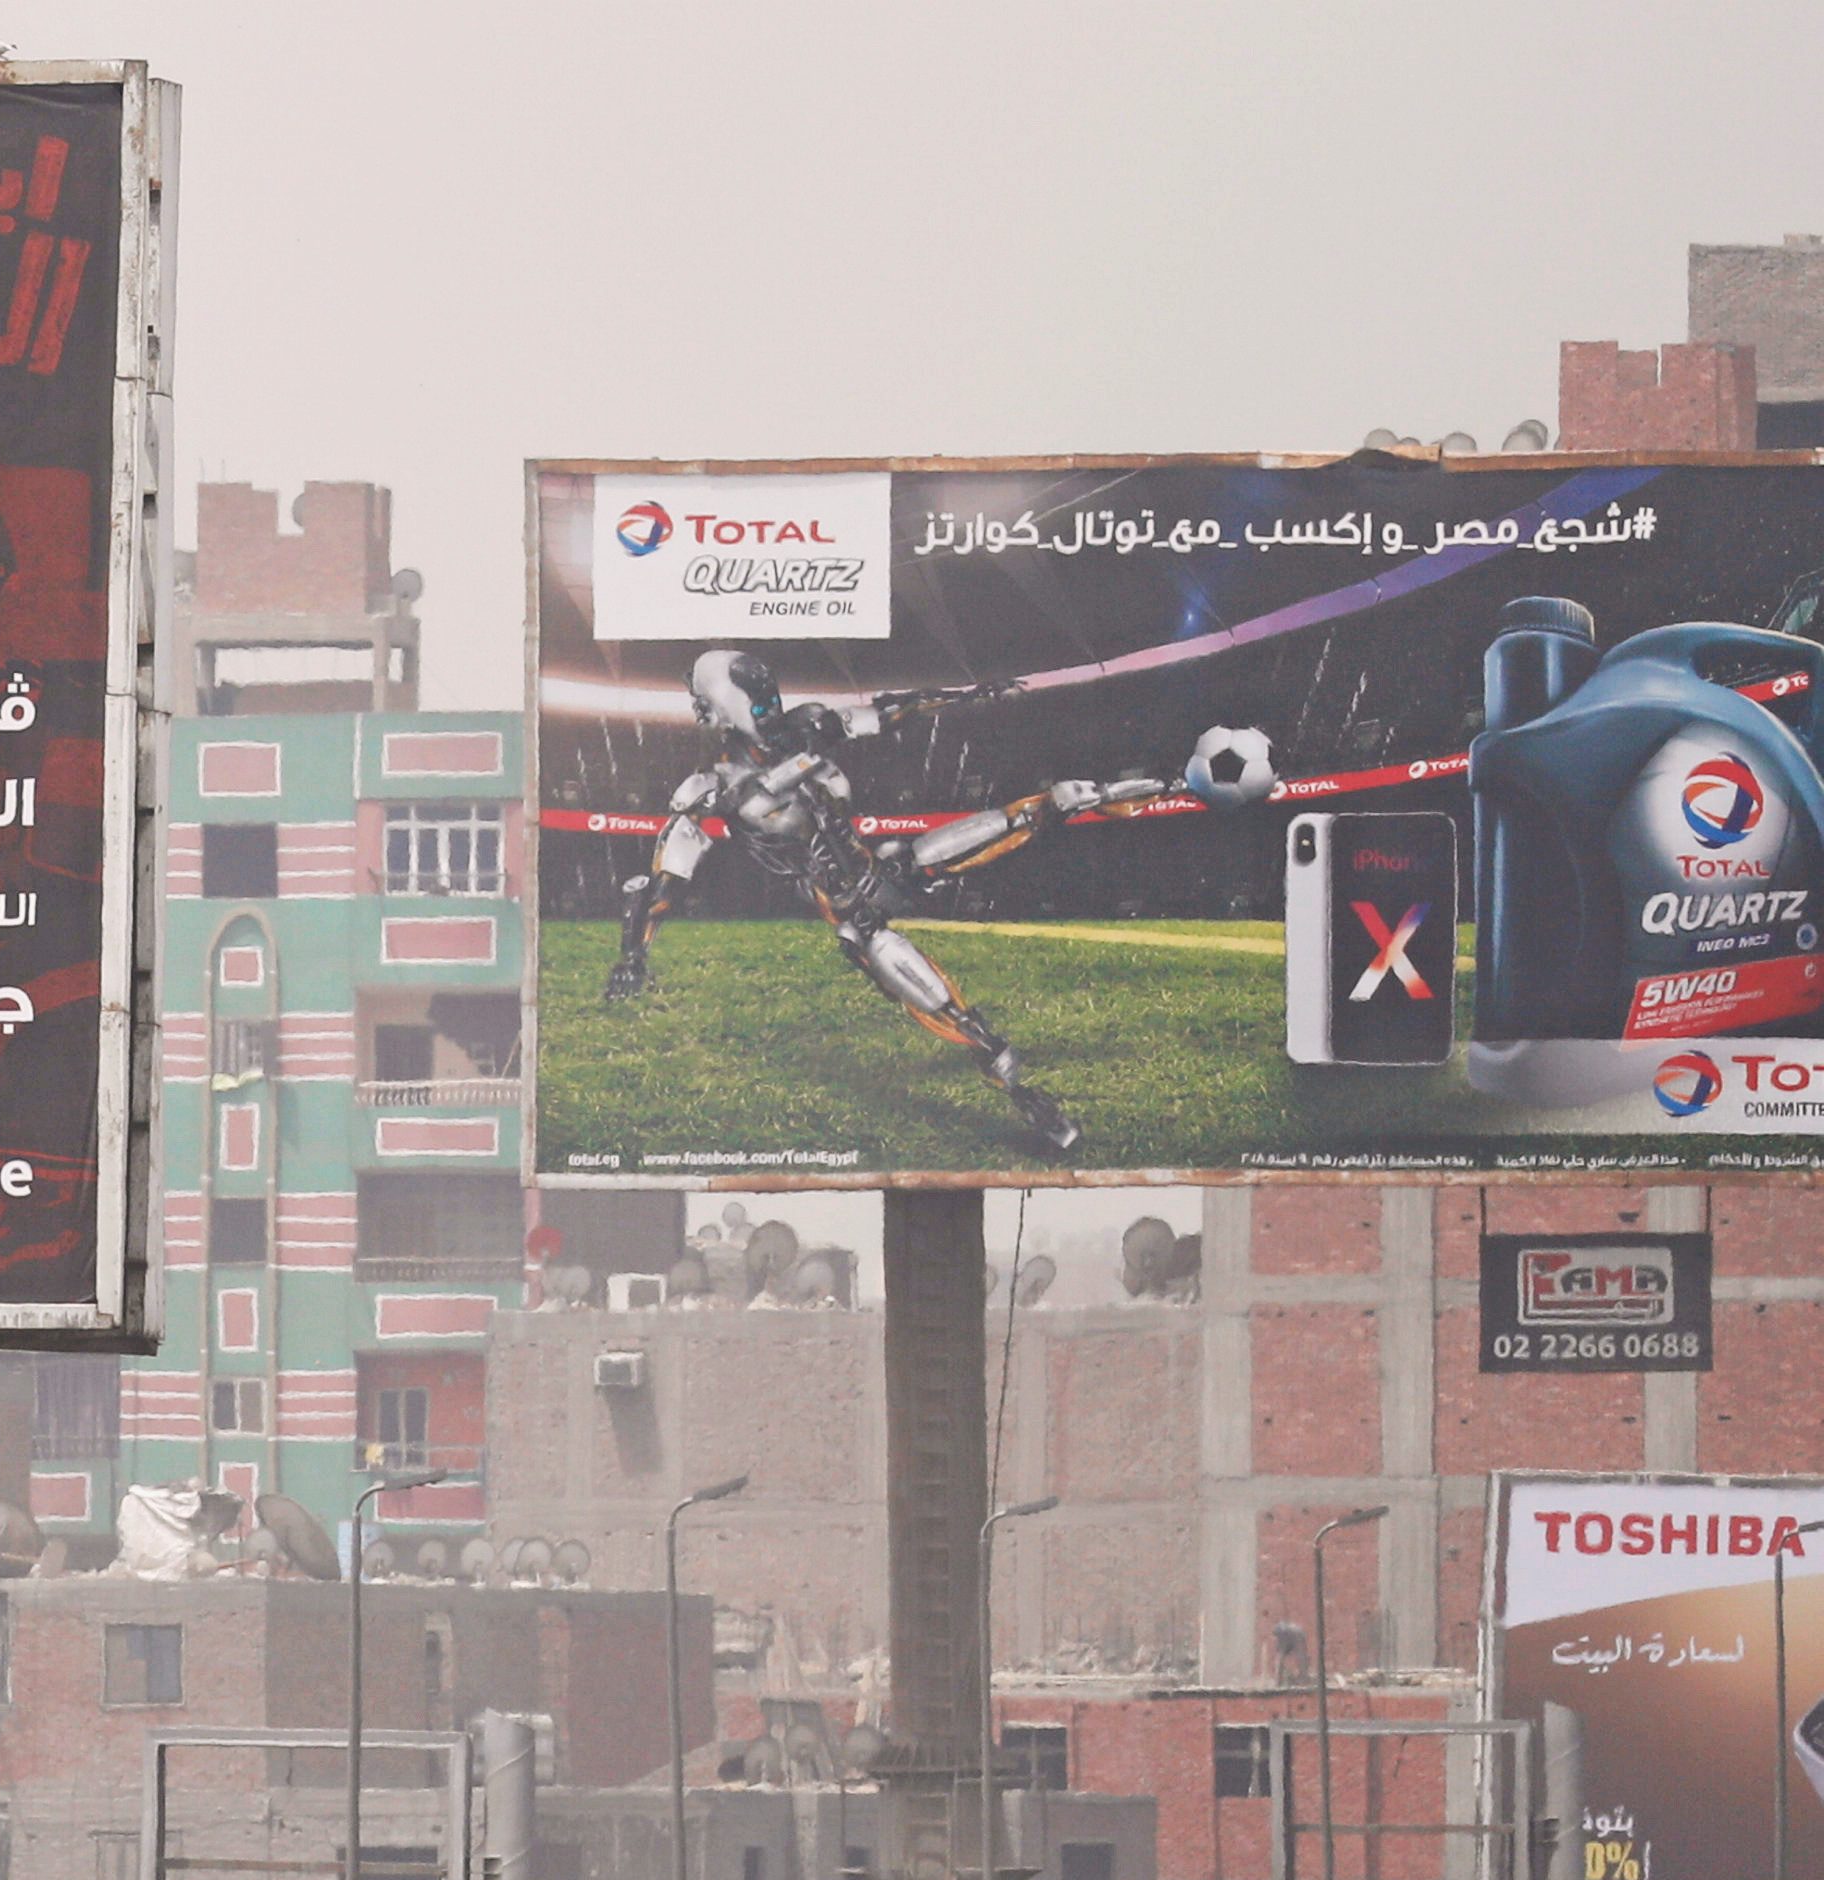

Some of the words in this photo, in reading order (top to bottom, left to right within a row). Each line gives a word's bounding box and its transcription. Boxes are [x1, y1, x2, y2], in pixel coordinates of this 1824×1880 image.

[686, 514, 836, 545] TOTAL
[684, 555, 864, 596] QUARTZ
[749, 602, 819, 617] ENGINE
[827, 602, 856, 616] OIL
[1429, 757, 1469, 773] TOTA
[1288, 778, 1339, 795] TOTAL
[607, 817, 657, 831] TOTAL
[879, 817, 928, 830] TOTAL
[1675, 855, 1770, 881] TOTAL
[1641, 890, 1809, 937] QUARTZ
[1348, 901, 1435, 1002] X
[1640, 969, 1737, 1008] 5W40
[1731, 1055, 1824, 1092] TO
[1493, 1335, 1530, 1359] 02
[1540, 1334, 1616, 1360] 2266
[1623, 1333, 1700, 1359] 0688
[1534, 1509, 1806, 1558] TOSHIBA
